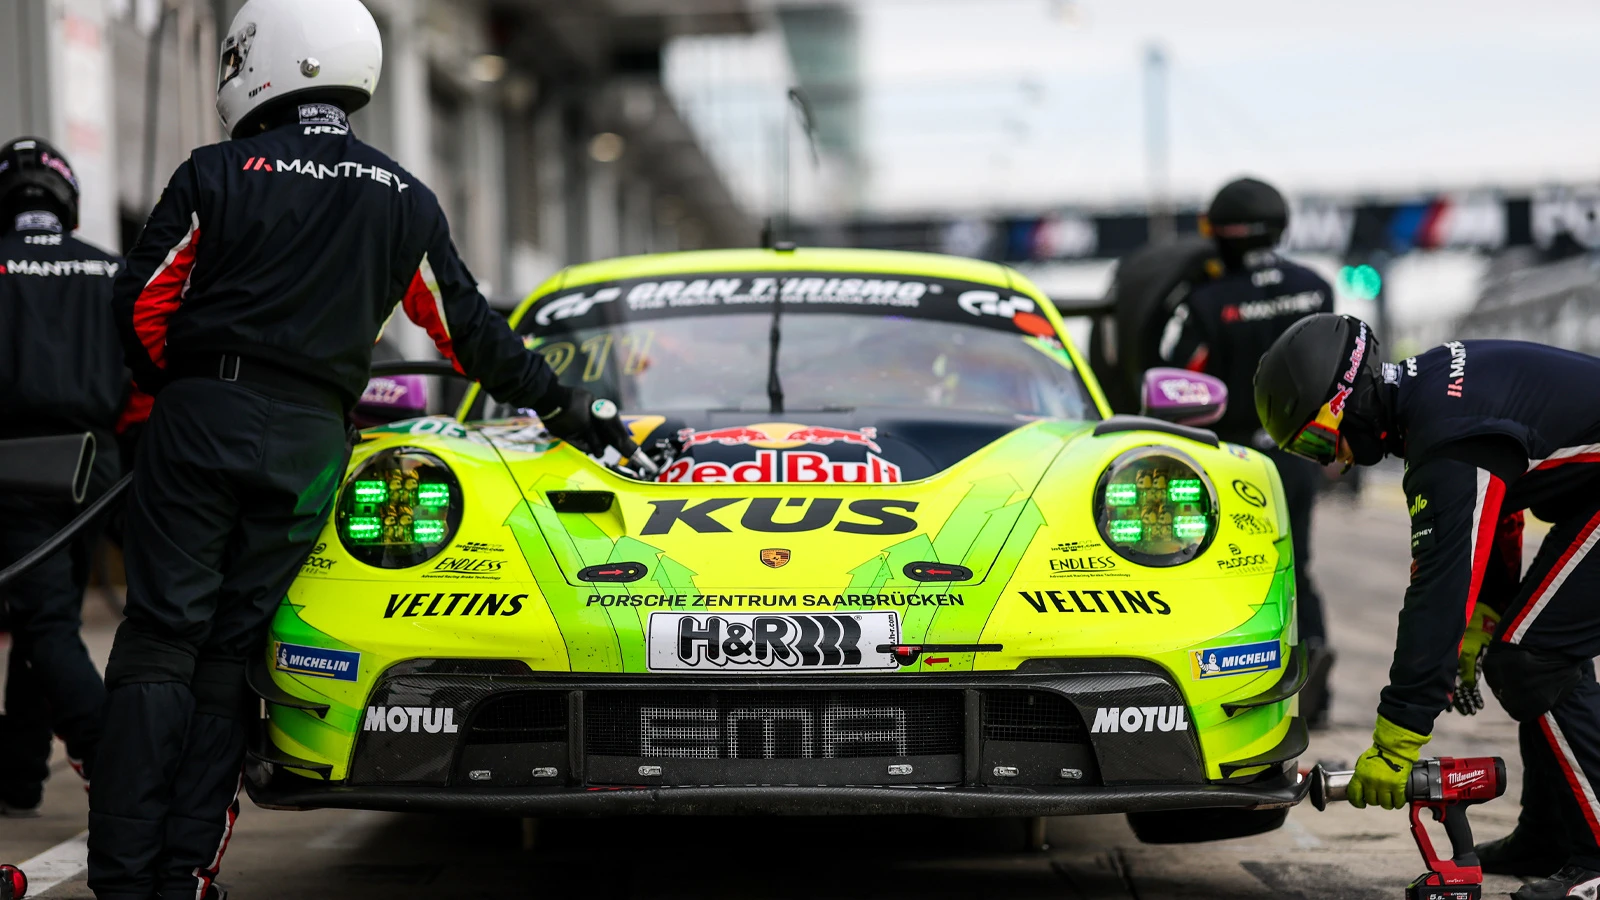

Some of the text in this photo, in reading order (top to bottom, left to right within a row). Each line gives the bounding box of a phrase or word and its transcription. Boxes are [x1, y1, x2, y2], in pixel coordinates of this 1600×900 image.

[276, 159, 409, 192] MANTHEY
[7, 260, 119, 277] MANTHEY
[627, 277, 927, 302] GRAN TURISMO
[639, 497, 919, 535] KÜS
[303, 556, 337, 570] DOCK
[434, 557, 508, 571] ENDLESS
[1049, 556, 1116, 571] ENDLESS
[1217, 554, 1268, 570] PADDOCK
[383, 593, 529, 619] VELTINS
[586, 591, 965, 607] PORSCHE ZENTRUM SAARBRÜCKEN
[1018, 590, 1171, 615] VELTINS
[677, 614, 801, 667] H&R
[289, 654, 350, 672] MICHELIN
[1221, 650, 1277, 667] MICHELIN
[363, 705, 458, 733] MOTUL
[1091, 705, 1189, 733] MOTUL
[640, 706, 906, 759] EMA
[1447, 769, 1485, 784] Milwaukee
